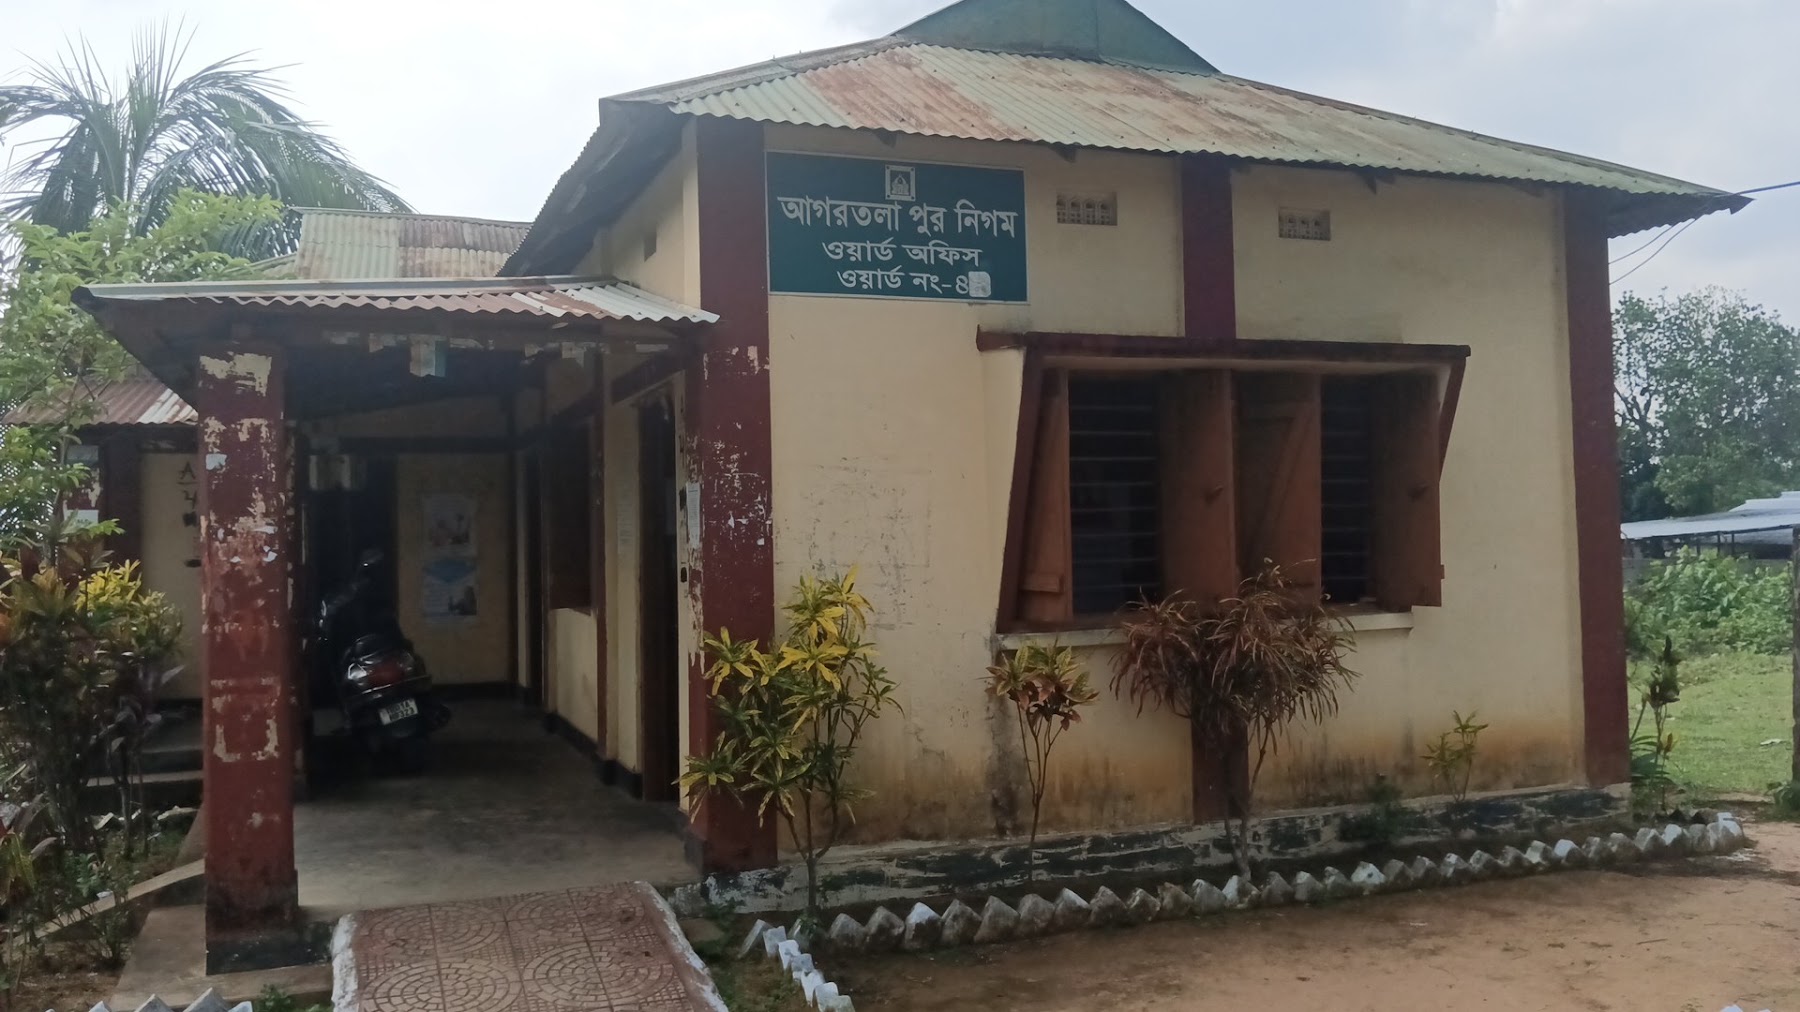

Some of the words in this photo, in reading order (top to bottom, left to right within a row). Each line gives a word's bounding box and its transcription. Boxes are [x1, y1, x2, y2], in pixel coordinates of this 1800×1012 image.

[777, 195, 902, 232] আগরতলা
[908, 203, 947, 237] পুর
[954, 199, 1019, 238] নিগম
[822, 237, 897, 262] ওয়ার্ড
[902, 240, 984, 267] অফিস
[836, 265, 905, 290] ওয়ার্ড
